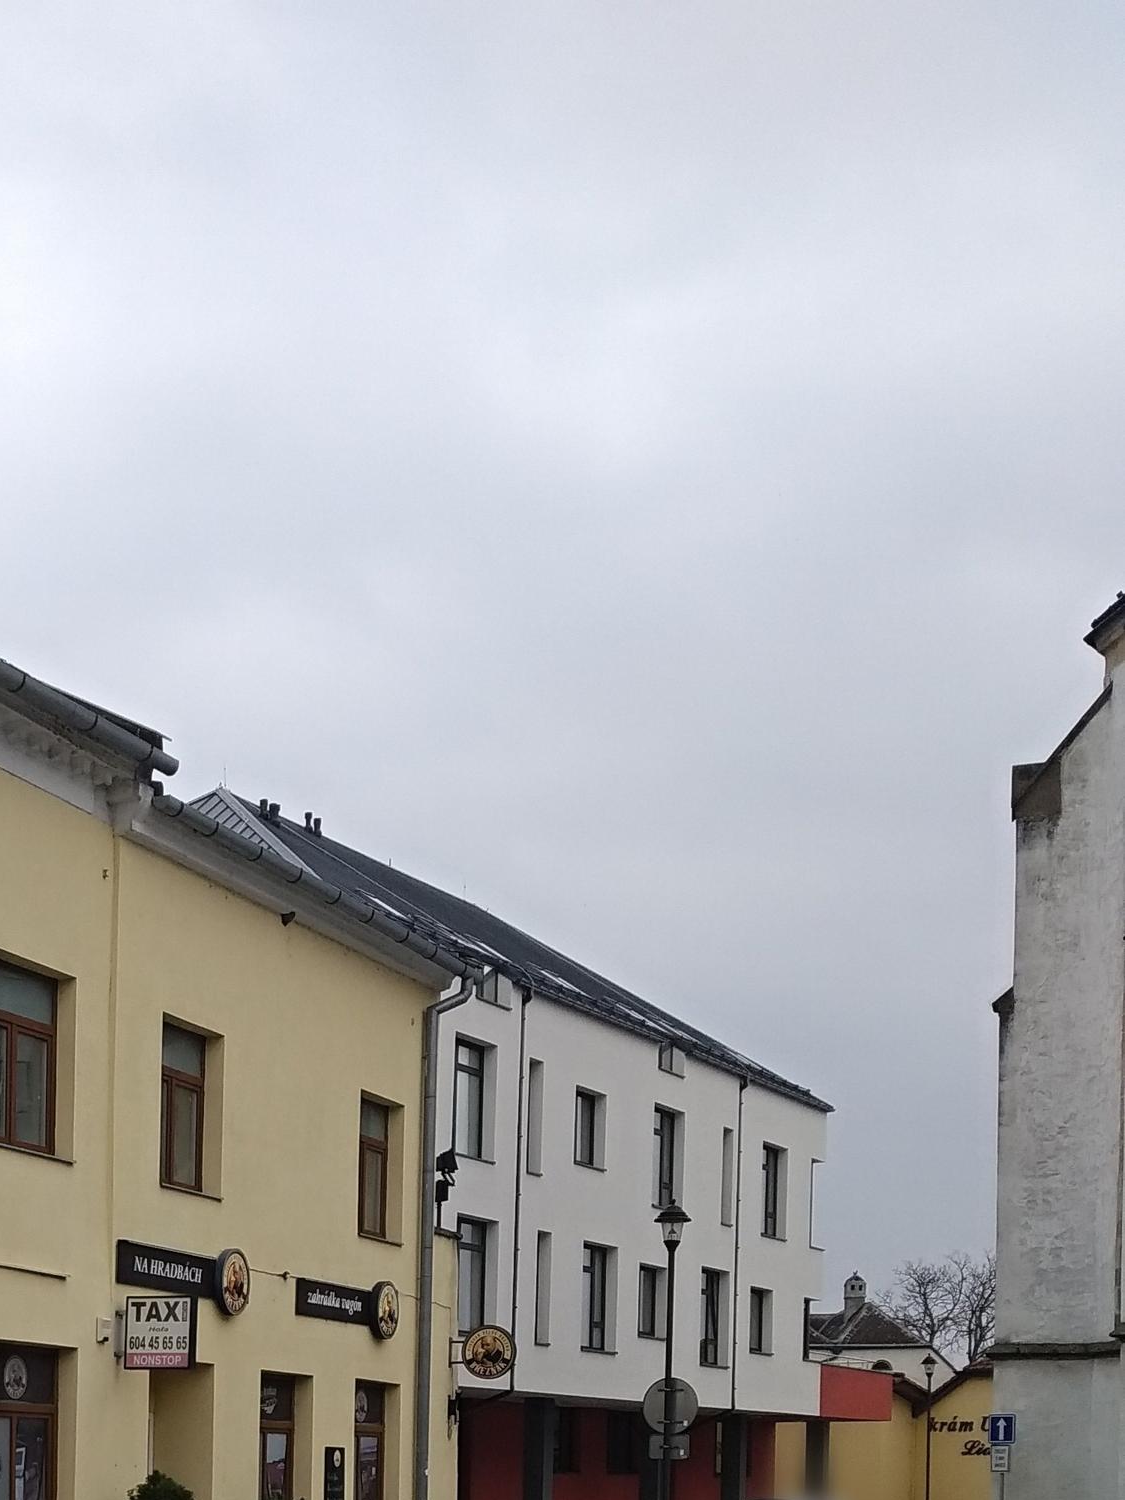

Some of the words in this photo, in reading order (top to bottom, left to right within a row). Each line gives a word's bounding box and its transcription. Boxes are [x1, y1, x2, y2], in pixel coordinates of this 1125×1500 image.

[133, 1256, 148, 1274] NA
[150, 1259, 203, 1284] HRADBÁCH
[307, 1288, 340, 1308] zahrádka
[129, 1336, 146, 1350] 604
[148, 1336, 160, 1350] 45
[162, 1336, 174, 1350] 65
[175, 1336, 187, 1350] 65
[133, 1355, 182, 1366] NONSTOP
